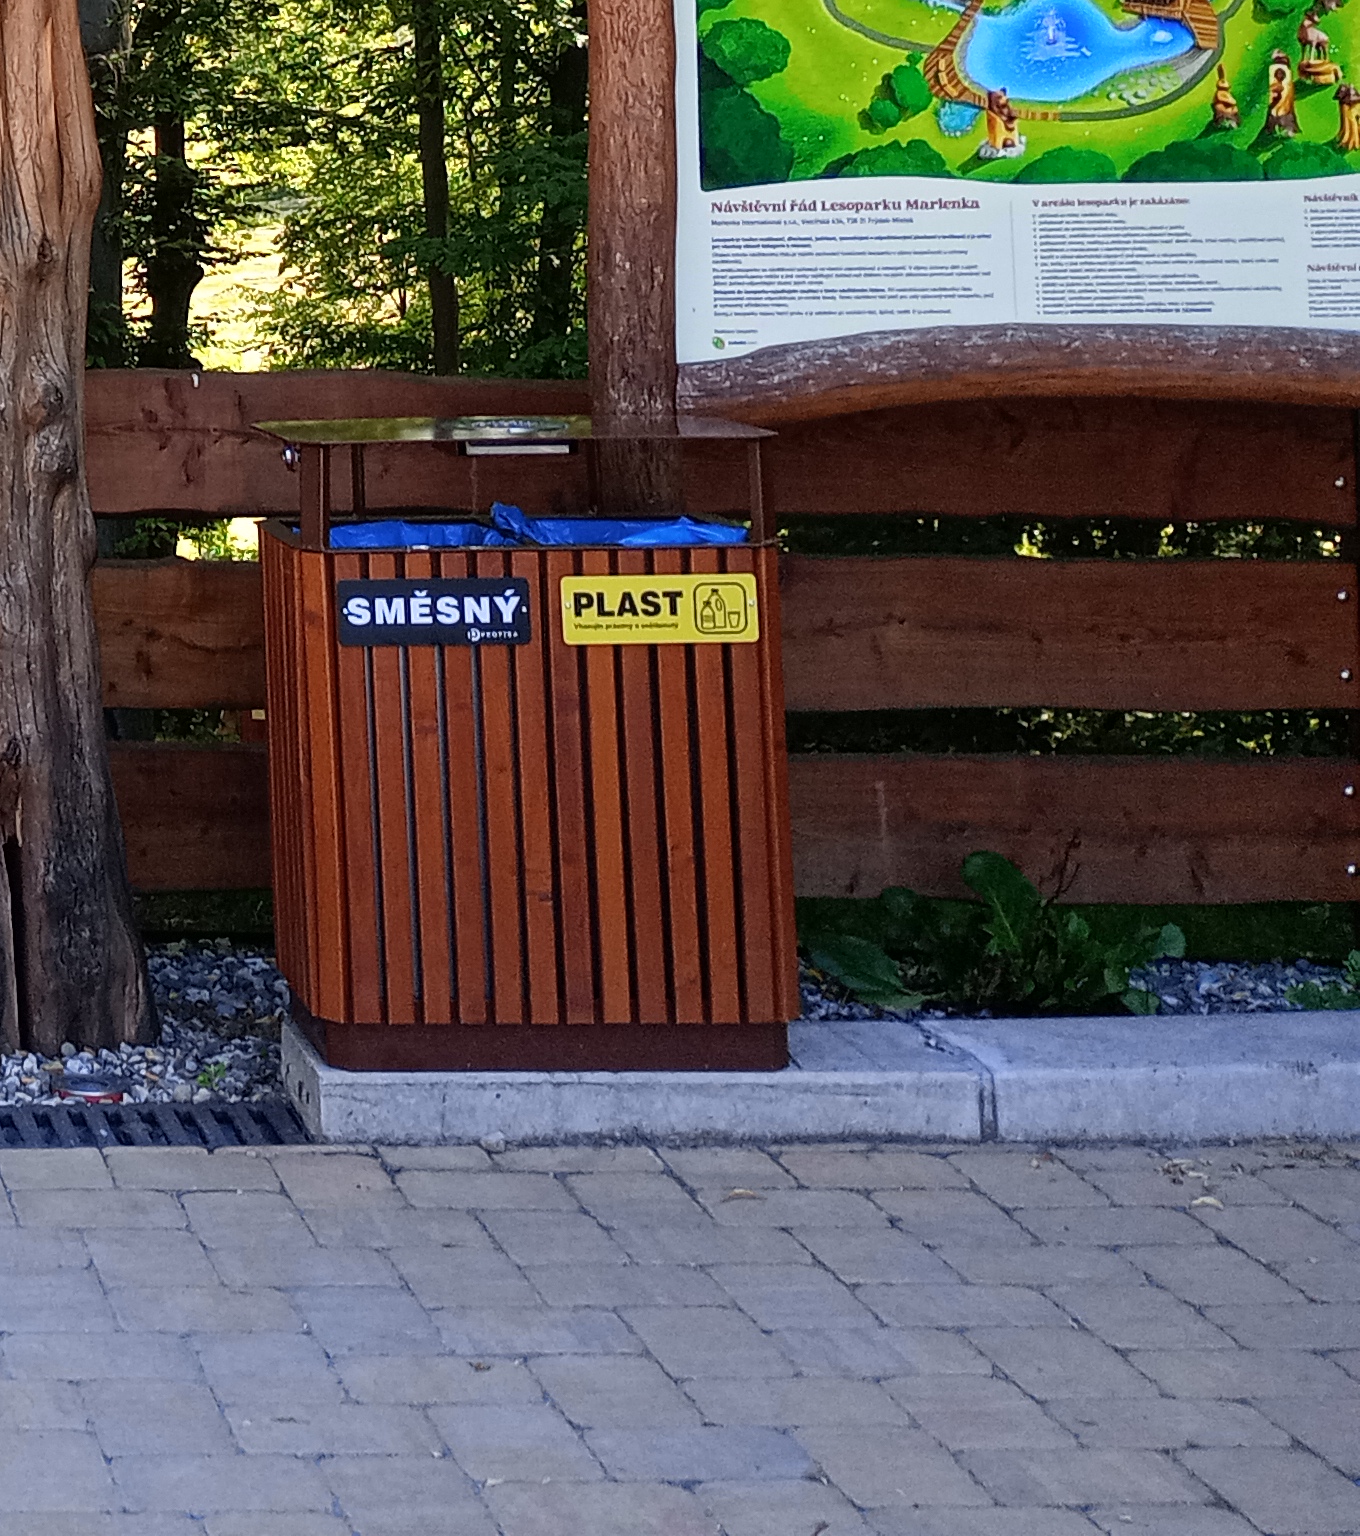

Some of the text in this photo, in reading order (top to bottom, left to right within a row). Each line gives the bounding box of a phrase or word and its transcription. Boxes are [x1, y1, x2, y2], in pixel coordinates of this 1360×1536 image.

[711, 196, 981, 214] Návštěvní řád Lesoparku Marlenka
[346, 588, 521, 626] SMĚSNÝ
[572, 590, 684, 618] PLAST
